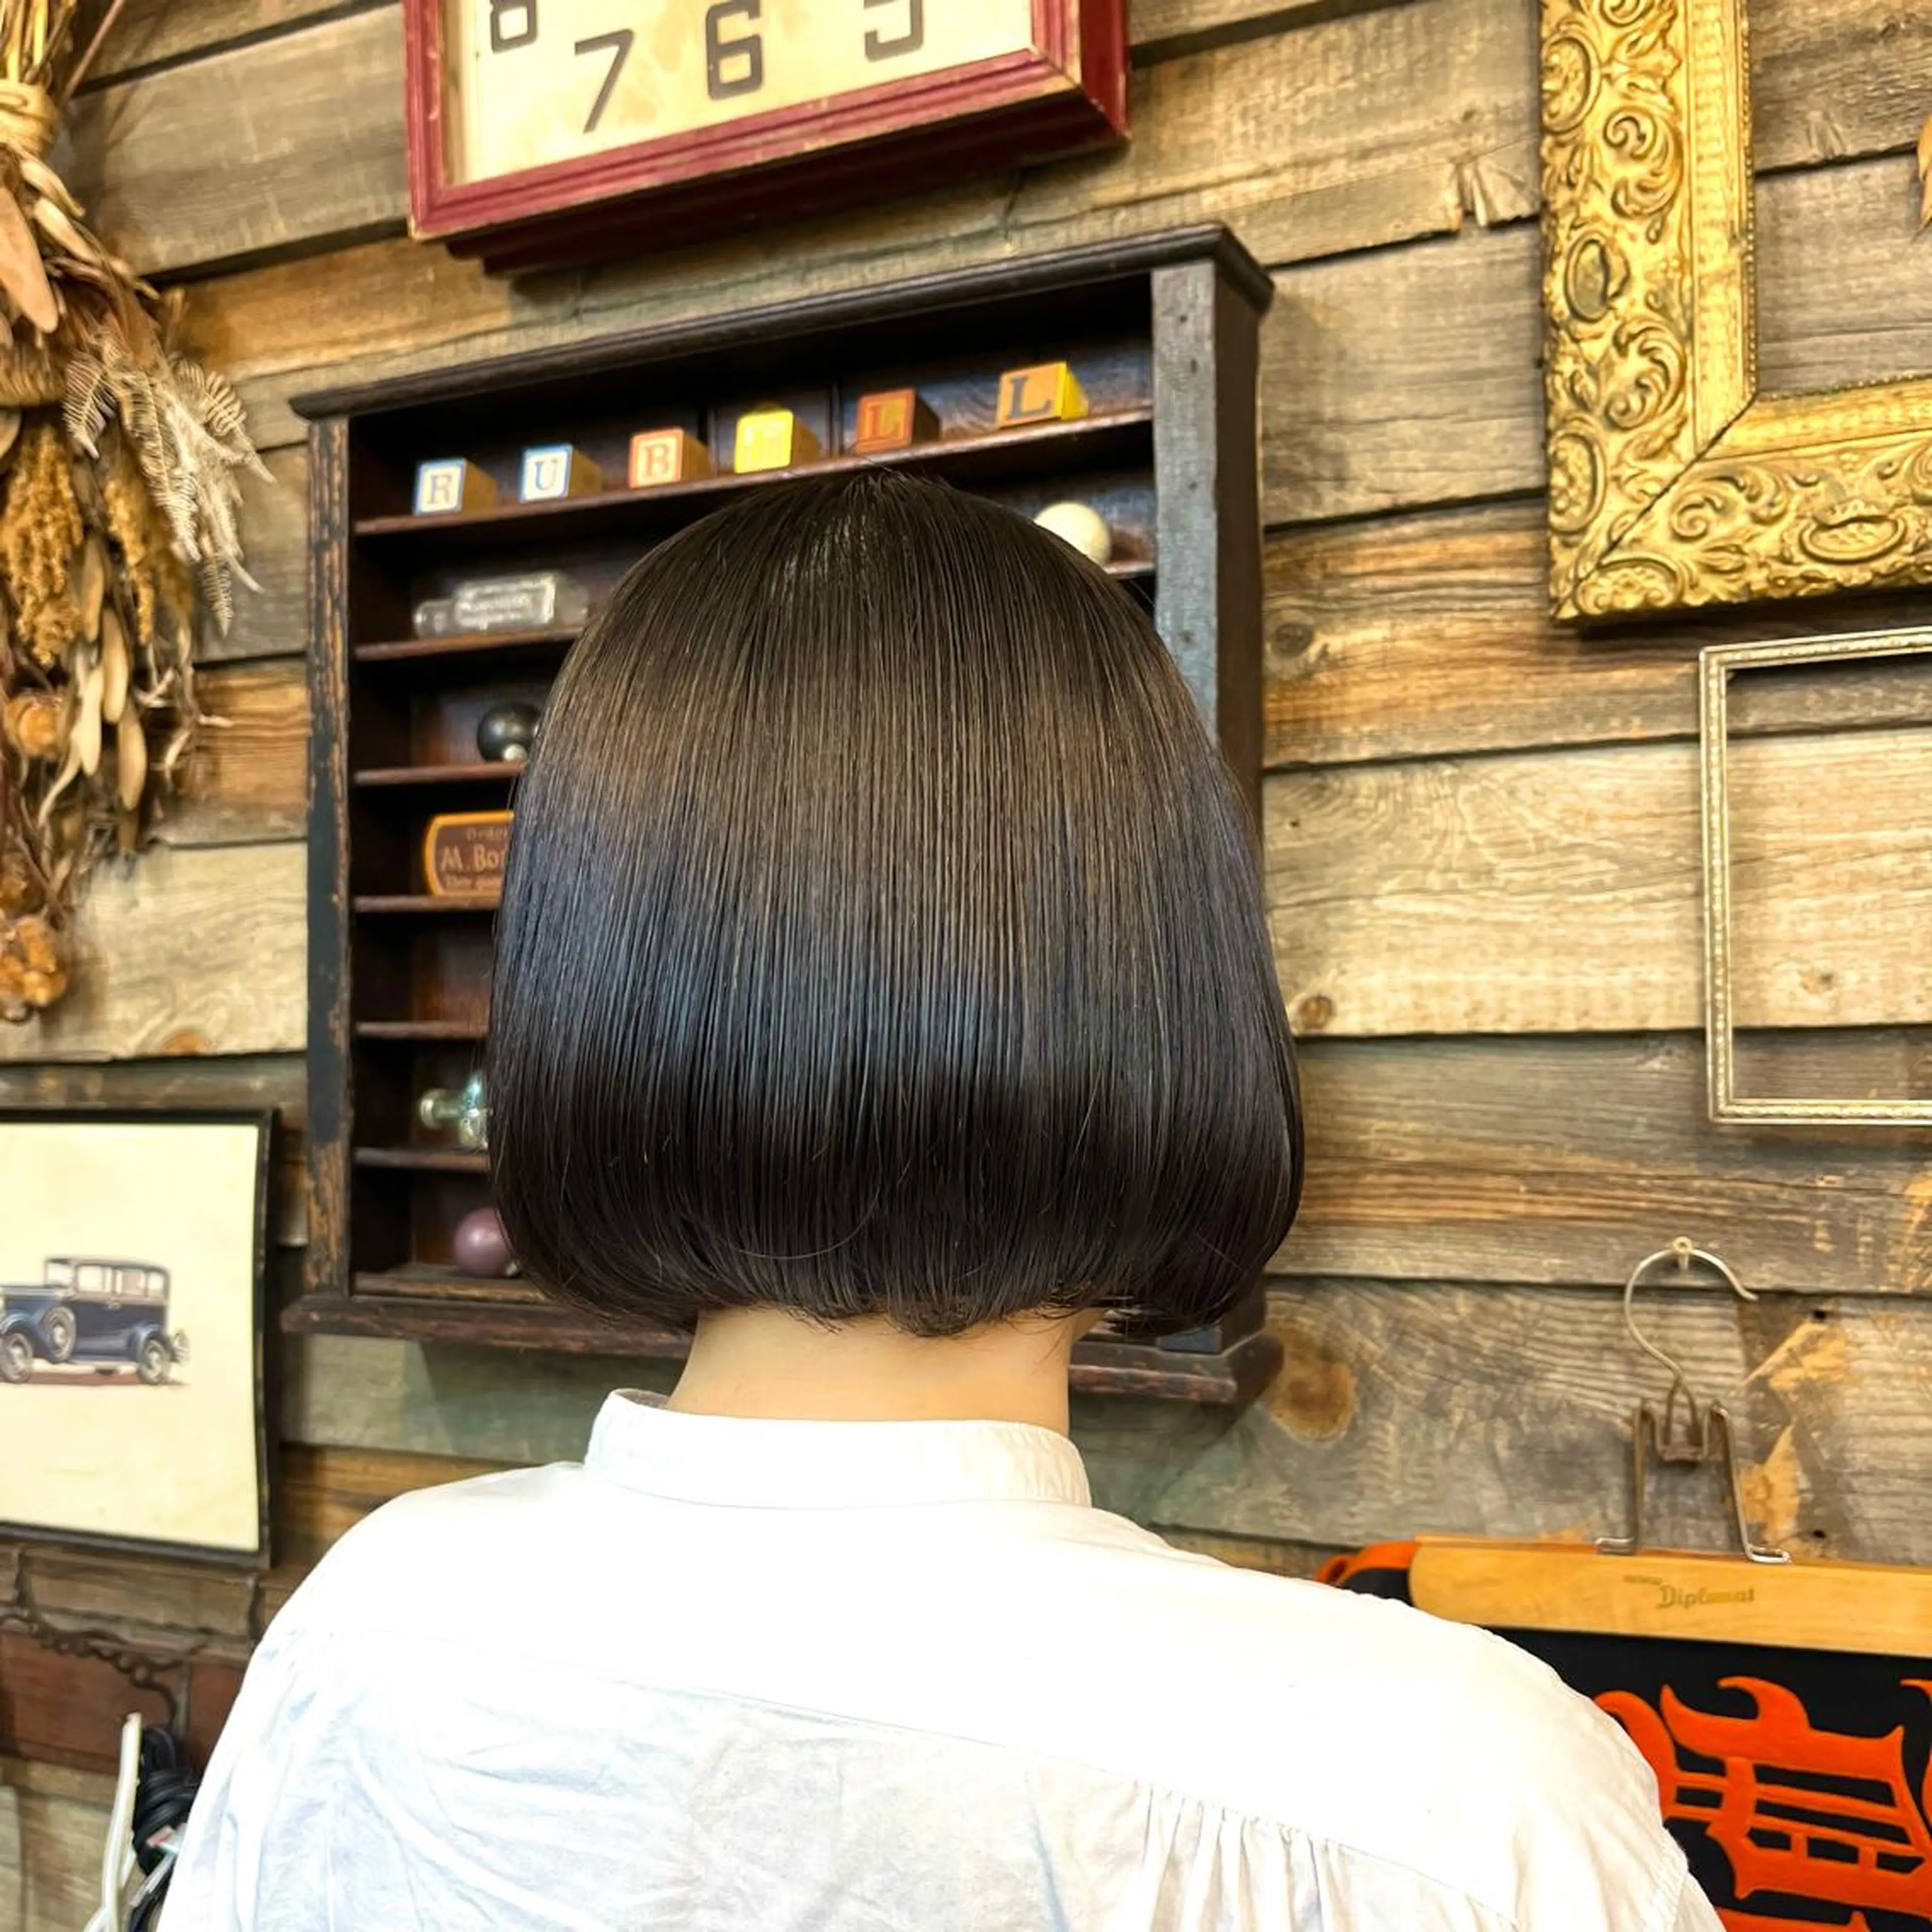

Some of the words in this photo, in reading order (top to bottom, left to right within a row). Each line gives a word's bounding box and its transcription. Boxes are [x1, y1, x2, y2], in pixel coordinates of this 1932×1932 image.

[575, 29, 634, 134] 7
[705, 0, 763, 100] 6
[430, 474, 452, 504] R
[535, 458, 558, 491] U
[645, 445, 669, 476] B
[1008, 376, 1052, 418] L
